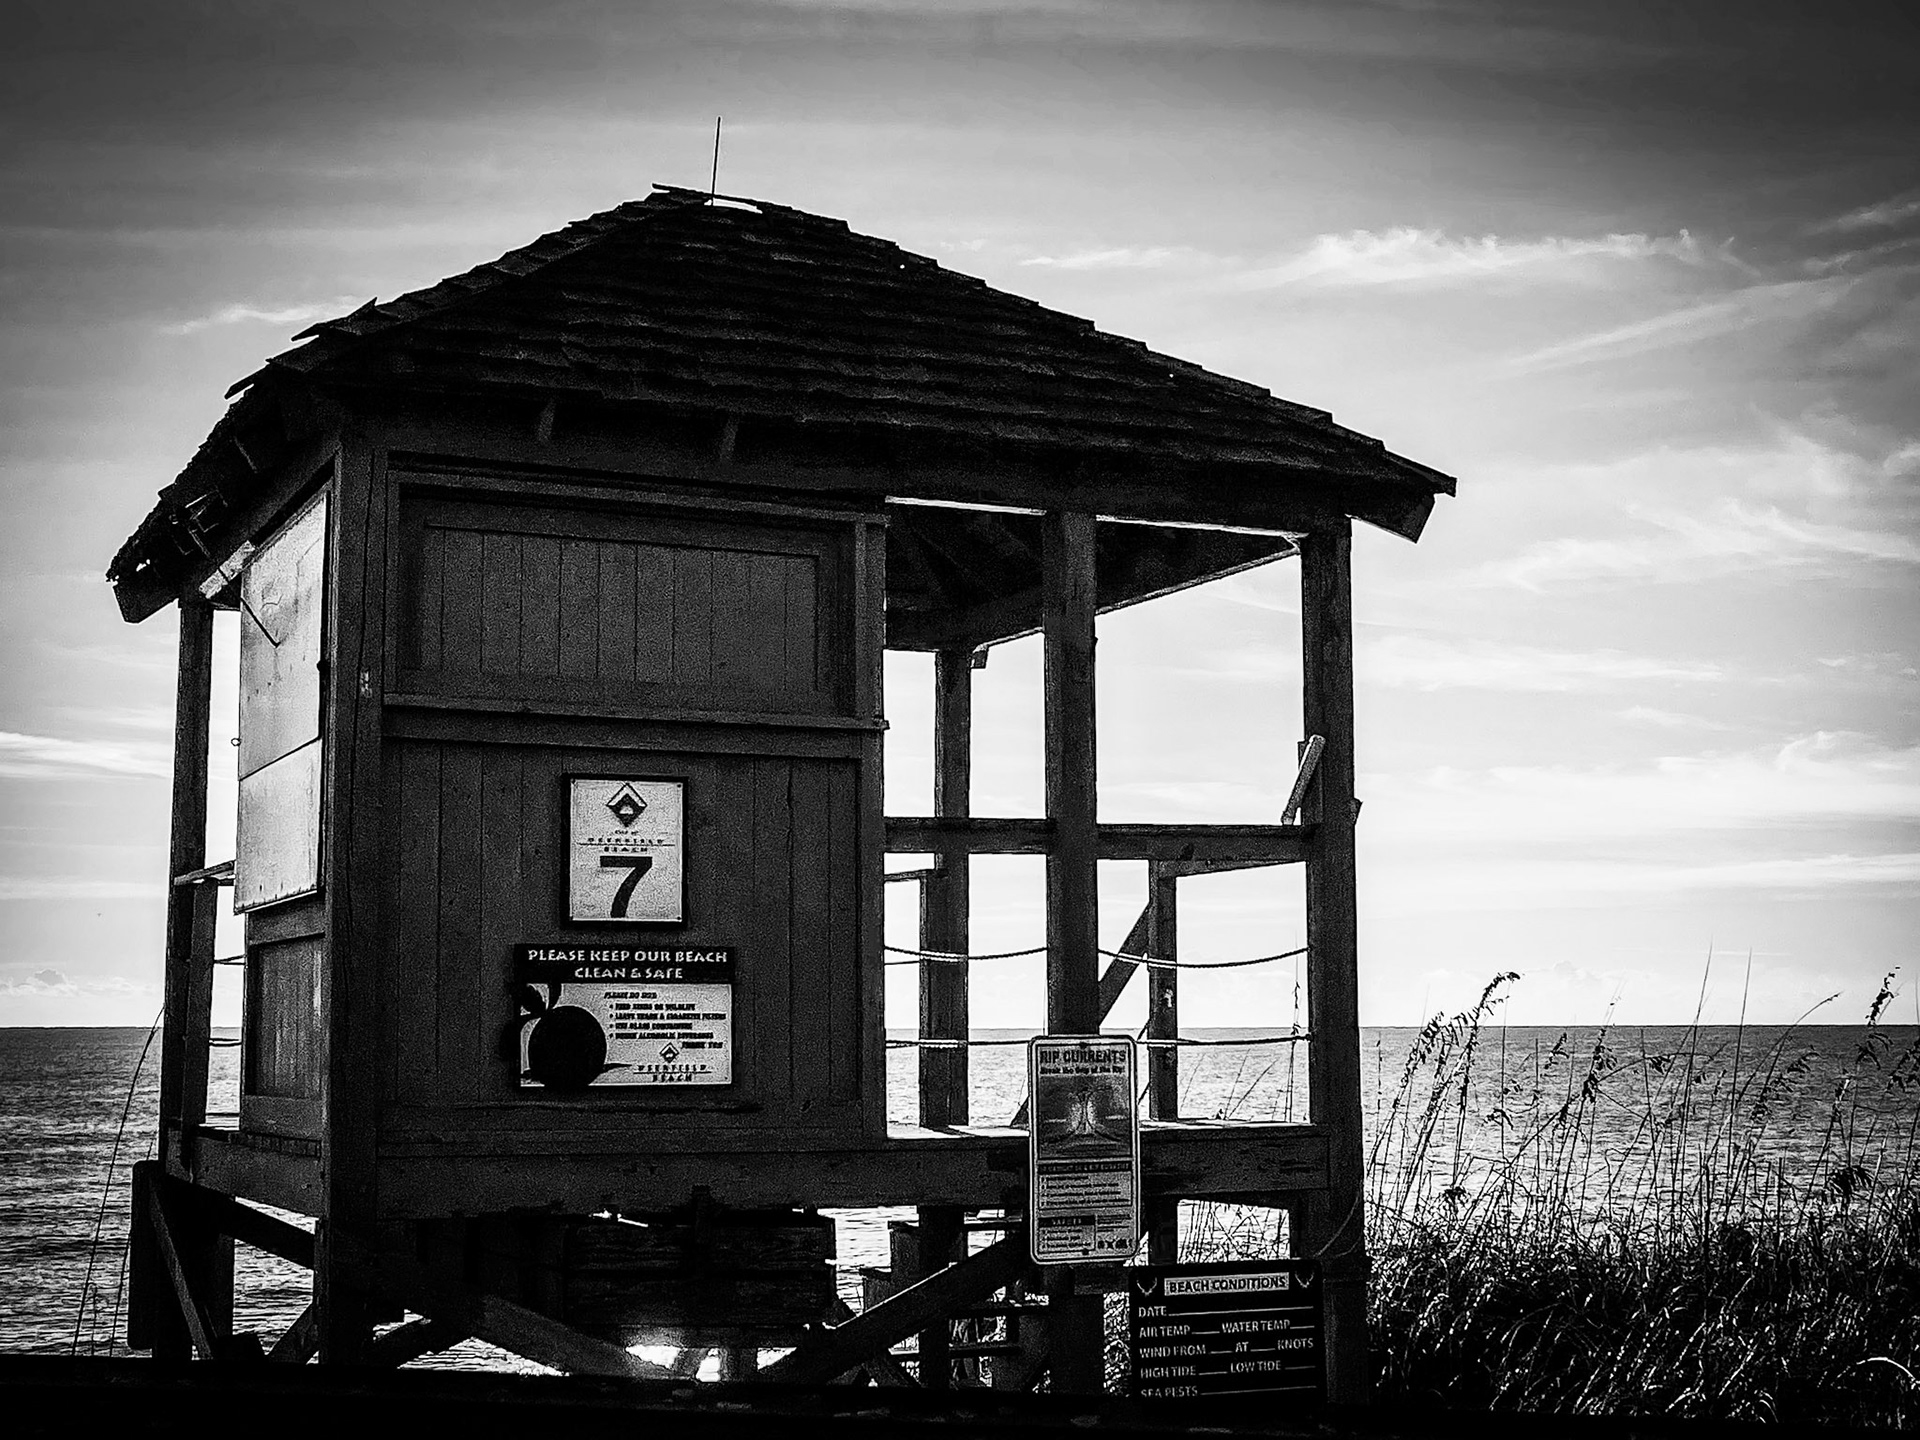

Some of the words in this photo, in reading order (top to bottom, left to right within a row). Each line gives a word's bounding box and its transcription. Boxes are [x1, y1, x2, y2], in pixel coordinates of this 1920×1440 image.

[600, 856, 653, 918] 7
[528, 949, 586, 962] PLEASE
[590, 950, 630, 962] KEEP
[634, 950, 671, 963] OUR
[675, 951, 728, 963] BEACH
[574, 967, 627, 979] CLEAN
[630, 968, 642, 979] &
[645, 968, 684, 979] SAFE
[1040, 1050, 1060, 1063] RIP
[1063, 1049, 1126, 1063] CURRENTS
[652, 1073, 692, 1082] BEACH
[1168, 1280, 1209, 1293] BEACH
[1210, 1276, 1286, 1292] CONDITIONS
[1138, 1306, 1168, 1318] DATE
[1139, 1327, 1158, 1338] AIR
[1160, 1325, 1191, 1337] TEMP
[1221, 1321, 1259, 1333] WATER
[1260, 1319, 1290, 1331] TEMP
[1139, 1346, 1171, 1358] WIND
[1173, 1344, 1206, 1356] FROM
[1234, 1341, 1249, 1353] AT
[1277, 1338, 1314, 1350] KNOTS
[1140, 1367, 1170, 1379] HIGH
[1171, 1365, 1197, 1377] TIDE
[1230, 1361, 1256, 1374] LOW
[1257, 1360, 1282, 1372] TIDE
[1141, 1387, 1162, 1398] SEA
[1164, 1385, 1198, 1398] PESTS
